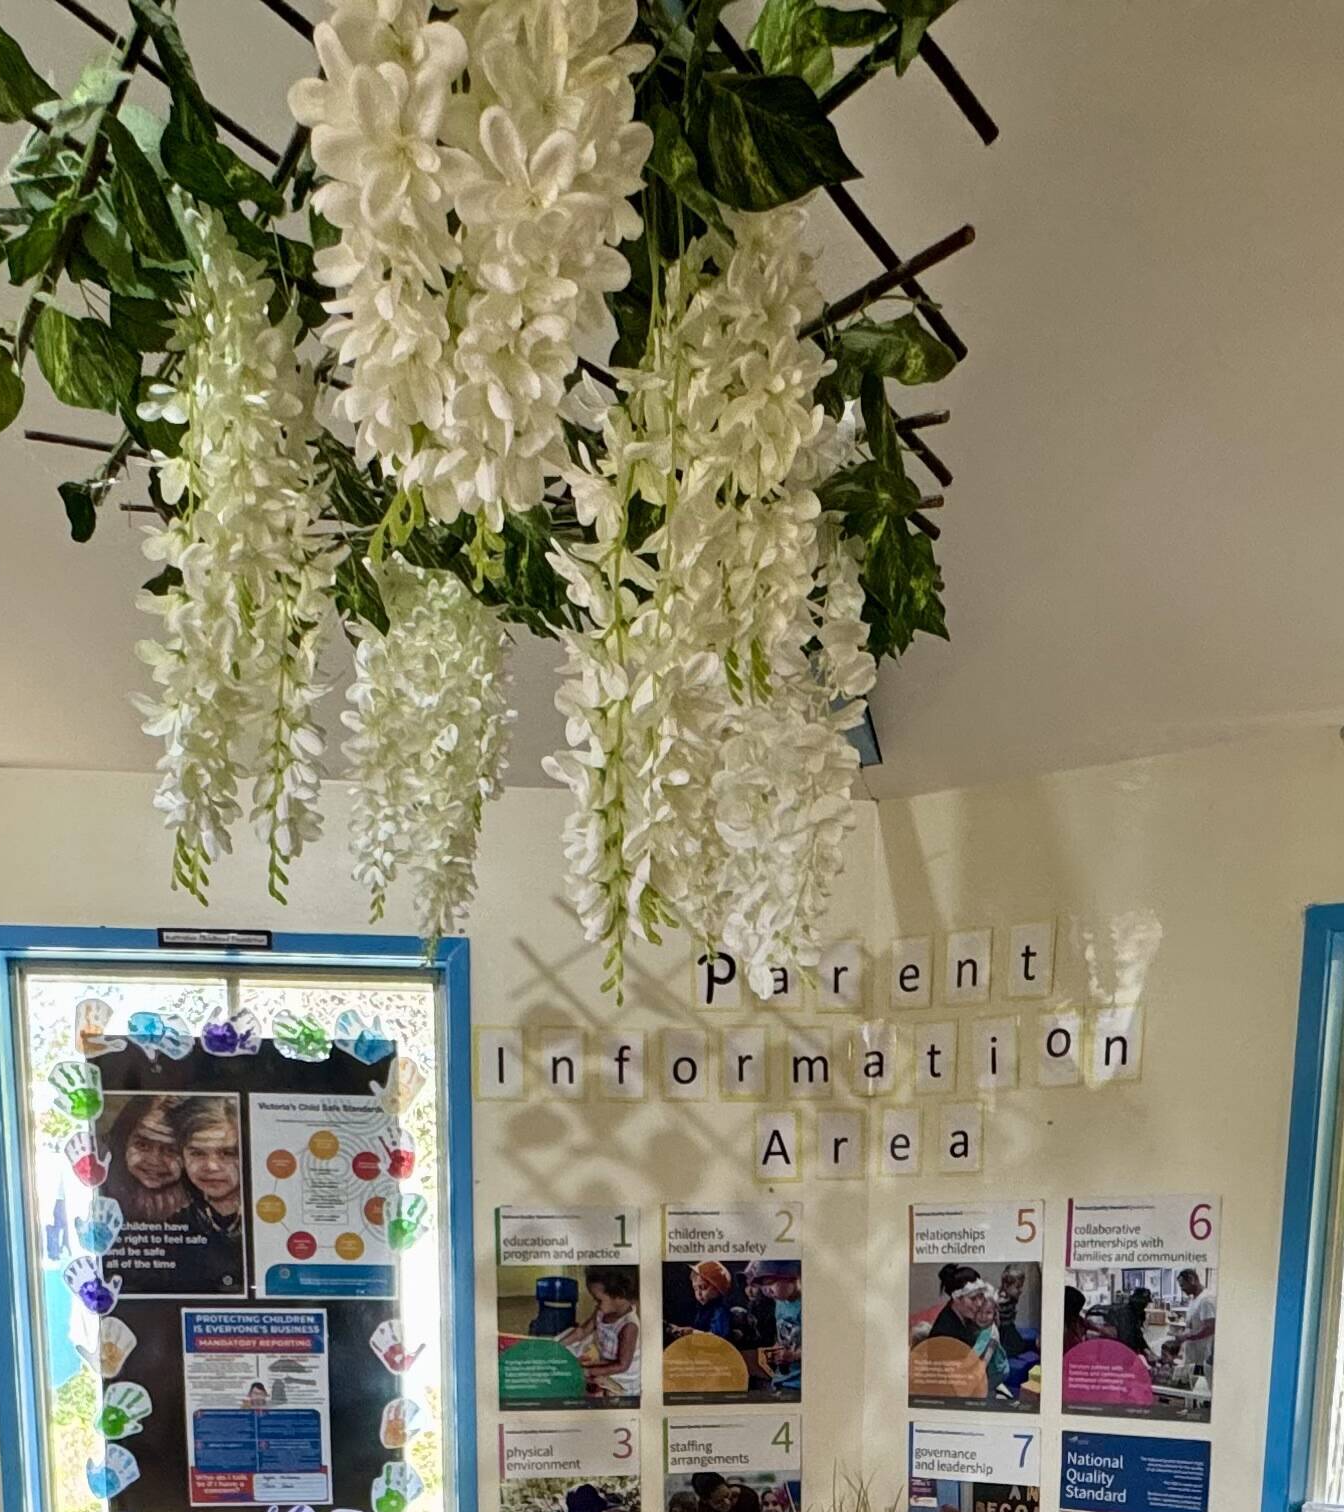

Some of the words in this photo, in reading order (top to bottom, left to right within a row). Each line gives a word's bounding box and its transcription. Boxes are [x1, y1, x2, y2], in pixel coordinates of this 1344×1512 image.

[496, 1027, 1129, 1086] Information
[762, 1127, 971, 1167] Area
[164, 1221, 189, 1232] have
[774, 1210, 794, 1243] 2
[1016, 1209, 1036, 1244] 5
[1189, 1204, 1212, 1240] 6
[613, 1214, 632, 1248] 1
[668, 1228, 723, 1240] children's
[916, 1228, 985, 1244] relationships
[1074, 1223, 1141, 1236] collaborative
[124, 1234, 148, 1245] right
[151, 1234, 162, 1244] to
[164, 1234, 183, 1244] feel
[186, 1234, 208, 1244] safe
[503, 1235, 568, 1247] educational
[1074, 1236, 1138, 1251] partnerships
[1140, 1237, 1164, 1248] with
[128, 1247, 141, 1256] be
[144, 1247, 165, 1257] safe
[504, 1249, 550, 1262] program
[552, 1248, 574, 1259] and
[577, 1248, 620, 1261] practice
[668, 1242, 704, 1254] health
[707, 1241, 729, 1253] and
[732, 1240, 766, 1256] safety
[916, 1243, 939, 1255] with
[941, 1242, 985, 1255] children
[1073, 1251, 1112, 1264] families
[1114, 1251, 1135, 1263] and
[1137, 1250, 1207, 1263] communities
[121, 1260, 132, 1269] of
[135, 1260, 151, 1269] the
[154, 1260, 176, 1269] time
[196, 1315, 259, 1323] PROTECTING
[263, 1315, 315, 1323] CHILDREN
[194, 1325, 203, 1333] IS
[206, 1325, 269, 1334] EVERYONE'S
[271, 1325, 320, 1334] BUSINESS
[199, 1339, 256, 1347] MANDATORY
[260, 1339, 312, 1347] REPORTING
[613, 1427, 632, 1459] 3
[771, 1421, 794, 1453] 4
[506, 1445, 553, 1460] physical
[670, 1441, 713, 1455] staffing
[915, 1448, 977, 1461] governance
[1013, 1434, 1034, 1468] 7
[506, 1458, 581, 1471] environment
[670, 1453, 750, 1467] arrangements
[1067, 1451, 1124, 1470] National
[914, 1460, 934, 1471] and
[937, 1460, 993, 1476] leadership
[1066, 1467, 1115, 1489] Quality
[1065, 1485, 1127, 1504] Standard
